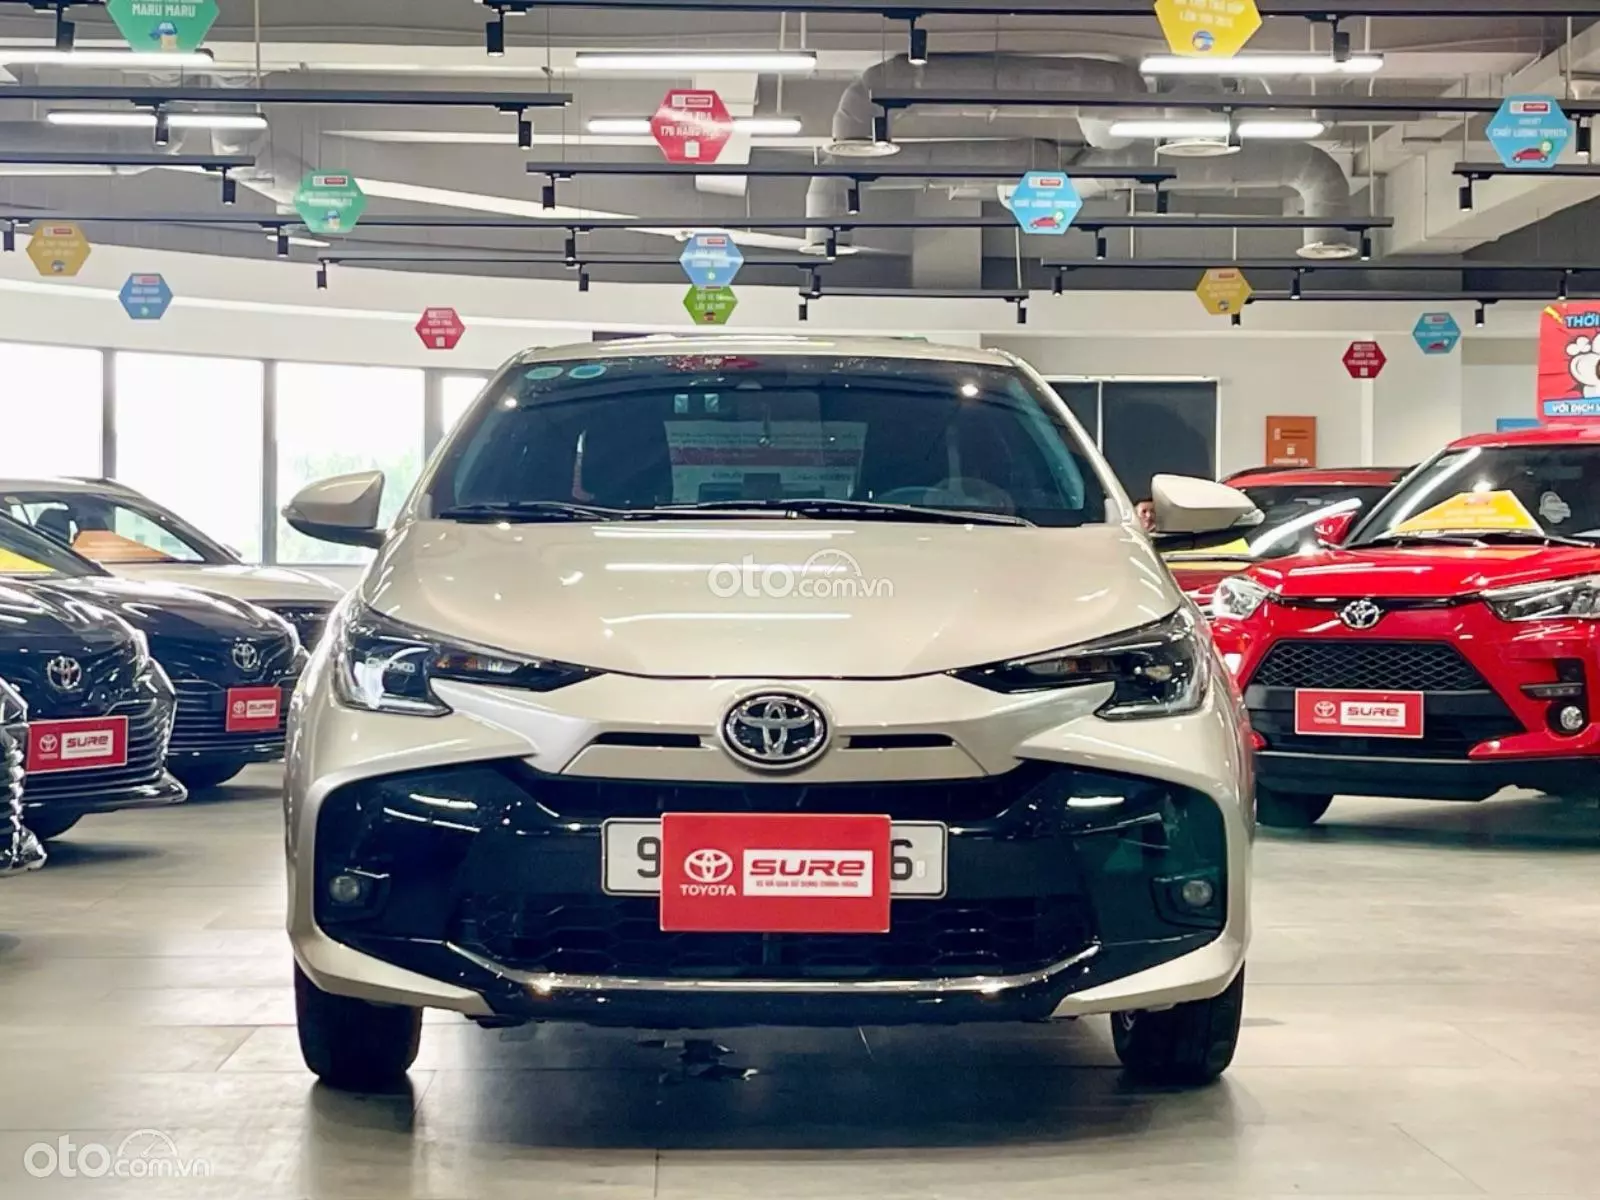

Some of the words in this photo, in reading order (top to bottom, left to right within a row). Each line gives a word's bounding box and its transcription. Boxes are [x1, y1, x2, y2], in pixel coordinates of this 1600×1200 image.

[132, 3, 162, 16] MARU
[165, 4, 196, 17] MARU
[680, 884, 736, 896] TOYOTA
